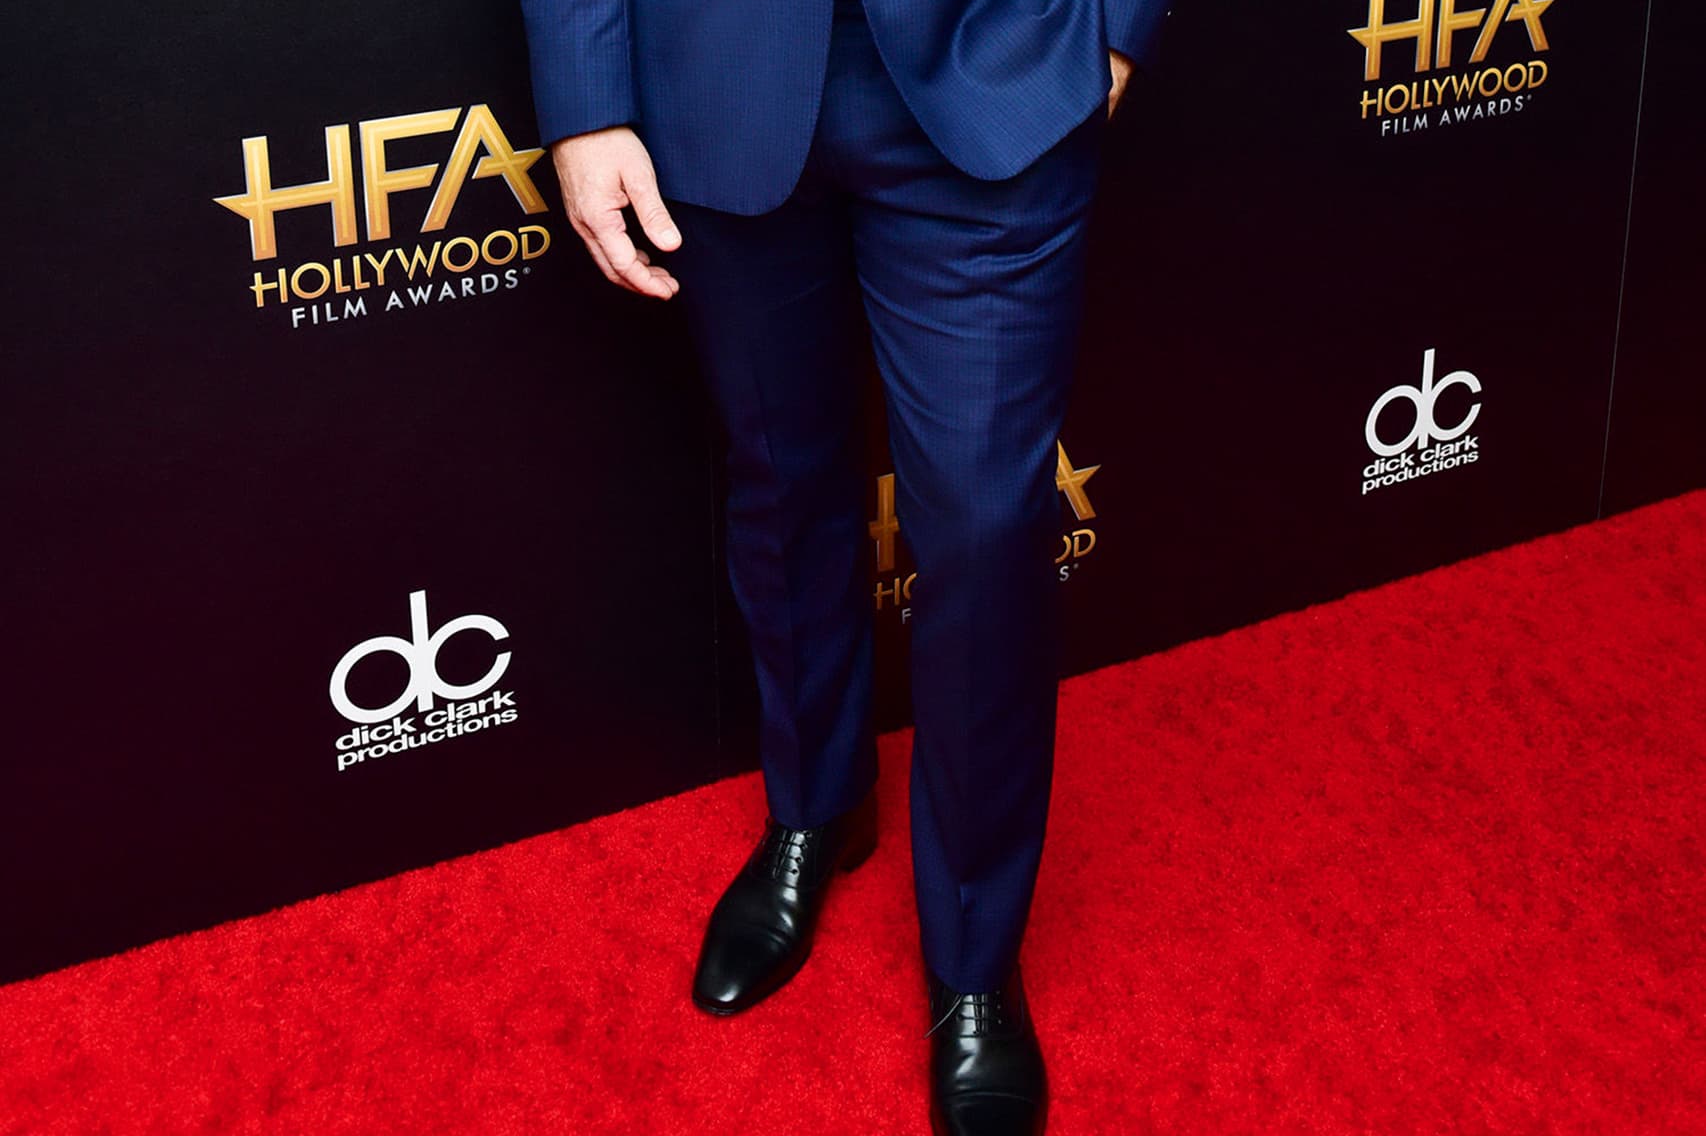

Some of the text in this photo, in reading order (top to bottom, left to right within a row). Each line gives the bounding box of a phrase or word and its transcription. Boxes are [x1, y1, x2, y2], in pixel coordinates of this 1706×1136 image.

[1360, 60, 1548, 119] HOLLYWOOD
[1381, 113, 1428, 137] FILM
[212, 103, 549, 261] HFA
[250, 225, 551, 307] HOLLYWOOD
[291, 296, 367, 329] FILM
[1362, 435, 1479, 478] dick clark
[1362, 451, 1479, 495] productions
[335, 691, 516, 750] dick clark
[337, 709, 518, 772] productions
